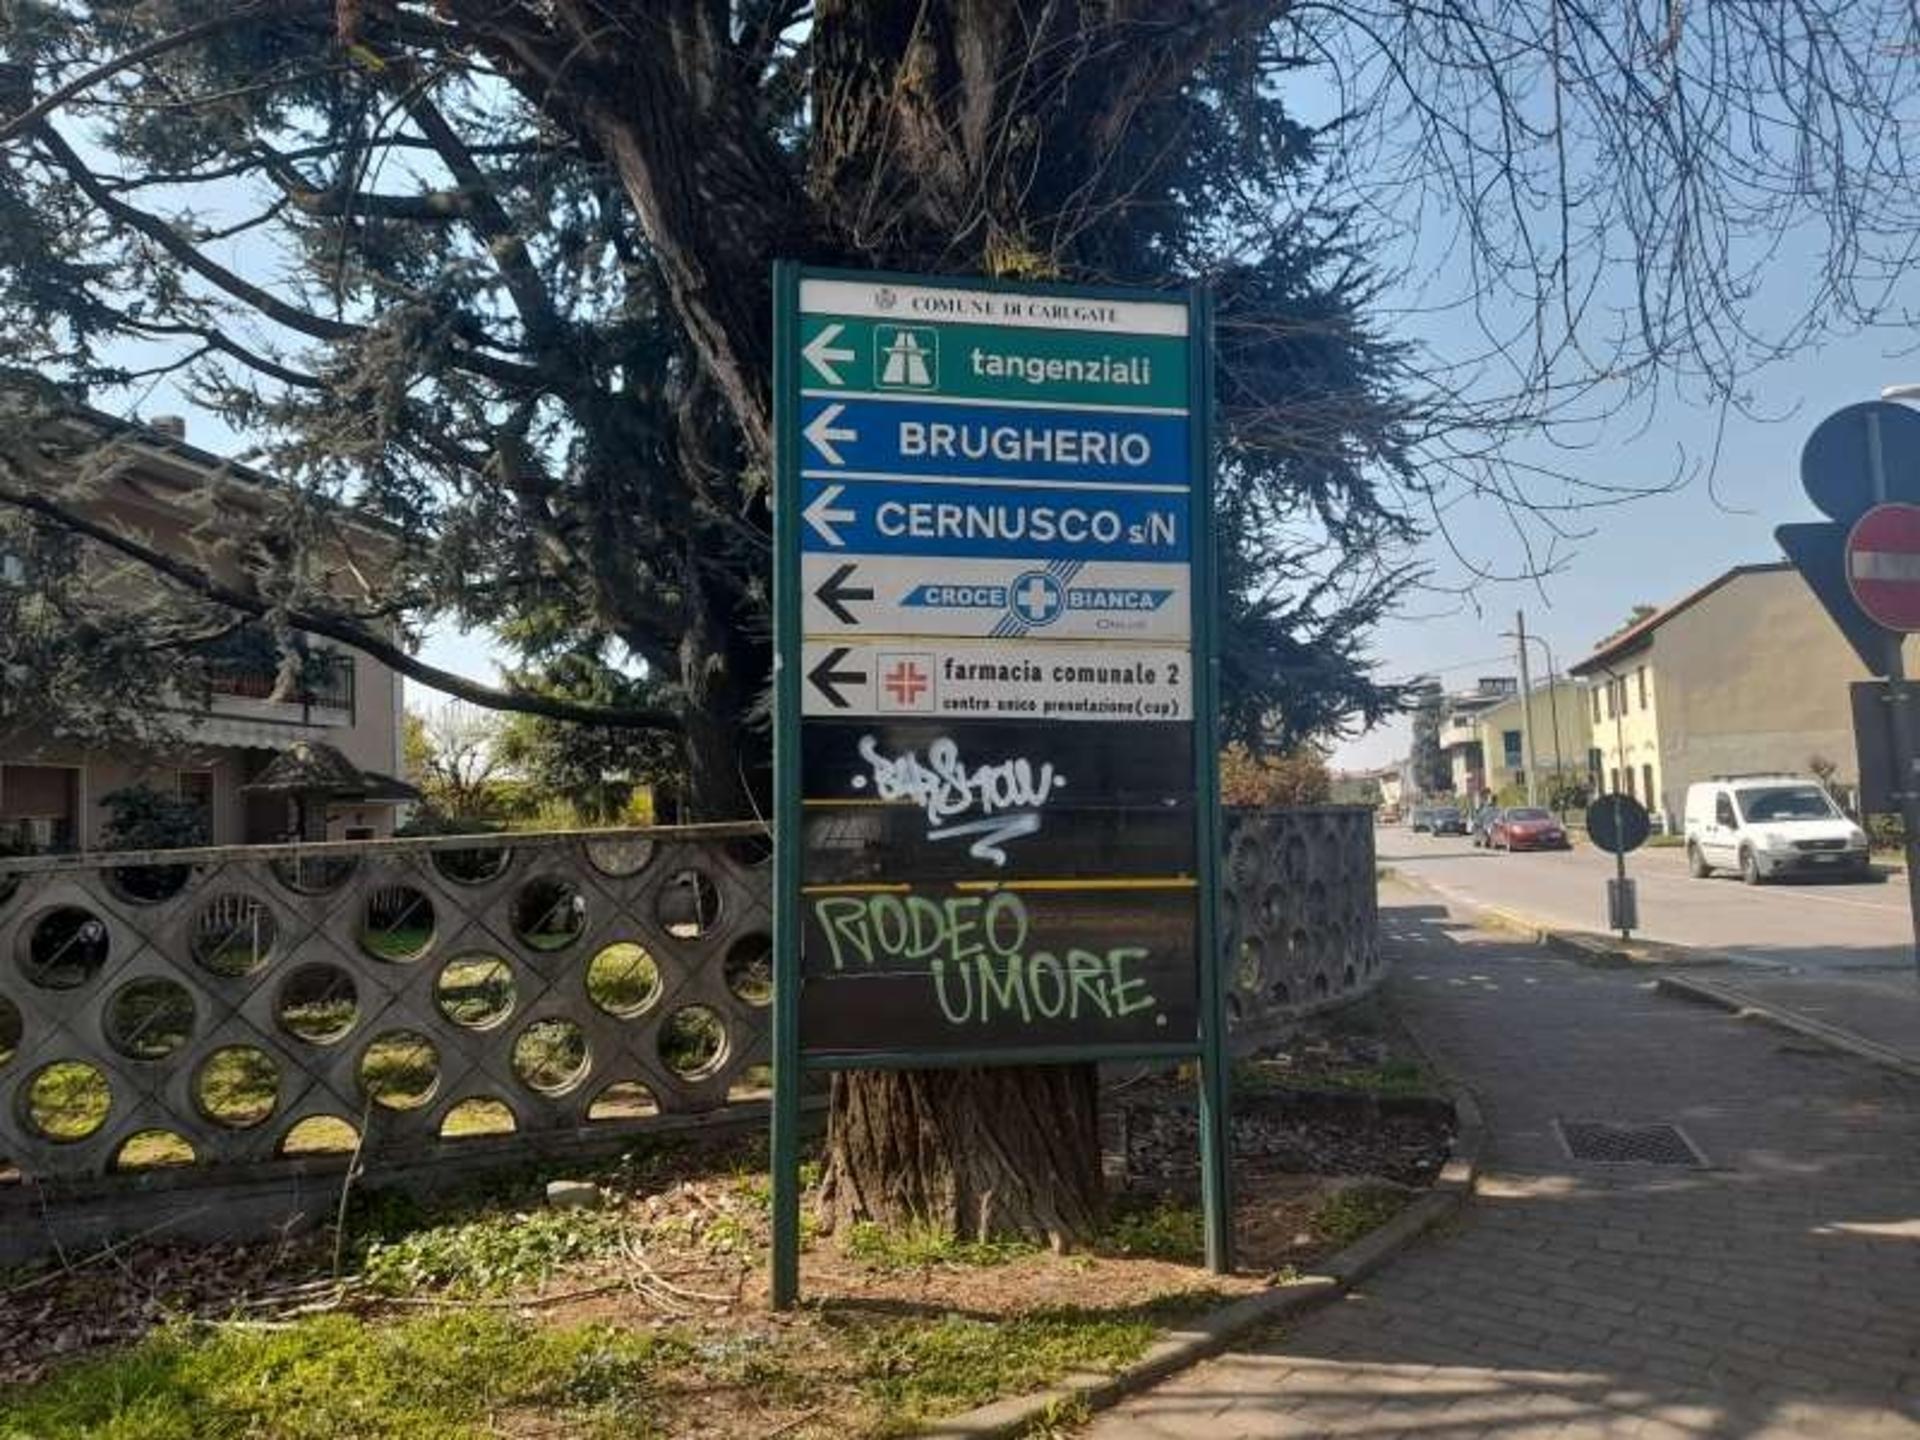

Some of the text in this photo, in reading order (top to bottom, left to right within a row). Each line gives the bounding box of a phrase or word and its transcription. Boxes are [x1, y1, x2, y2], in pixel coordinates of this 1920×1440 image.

[911, 297, 992, 316] COMUNE
[1004, 300, 1022, 316] DI
[971, 347, 1152, 386] tangenziali
[900, 421, 1151, 466] BRUGHERIO
[875, 501, 1121, 544] CERNUSCO
[925, 586, 1155, 610] CROCE BIANCA
[944, 657, 1180, 685] farmacia comunale 2
[815, 893, 1028, 970] RODEO
